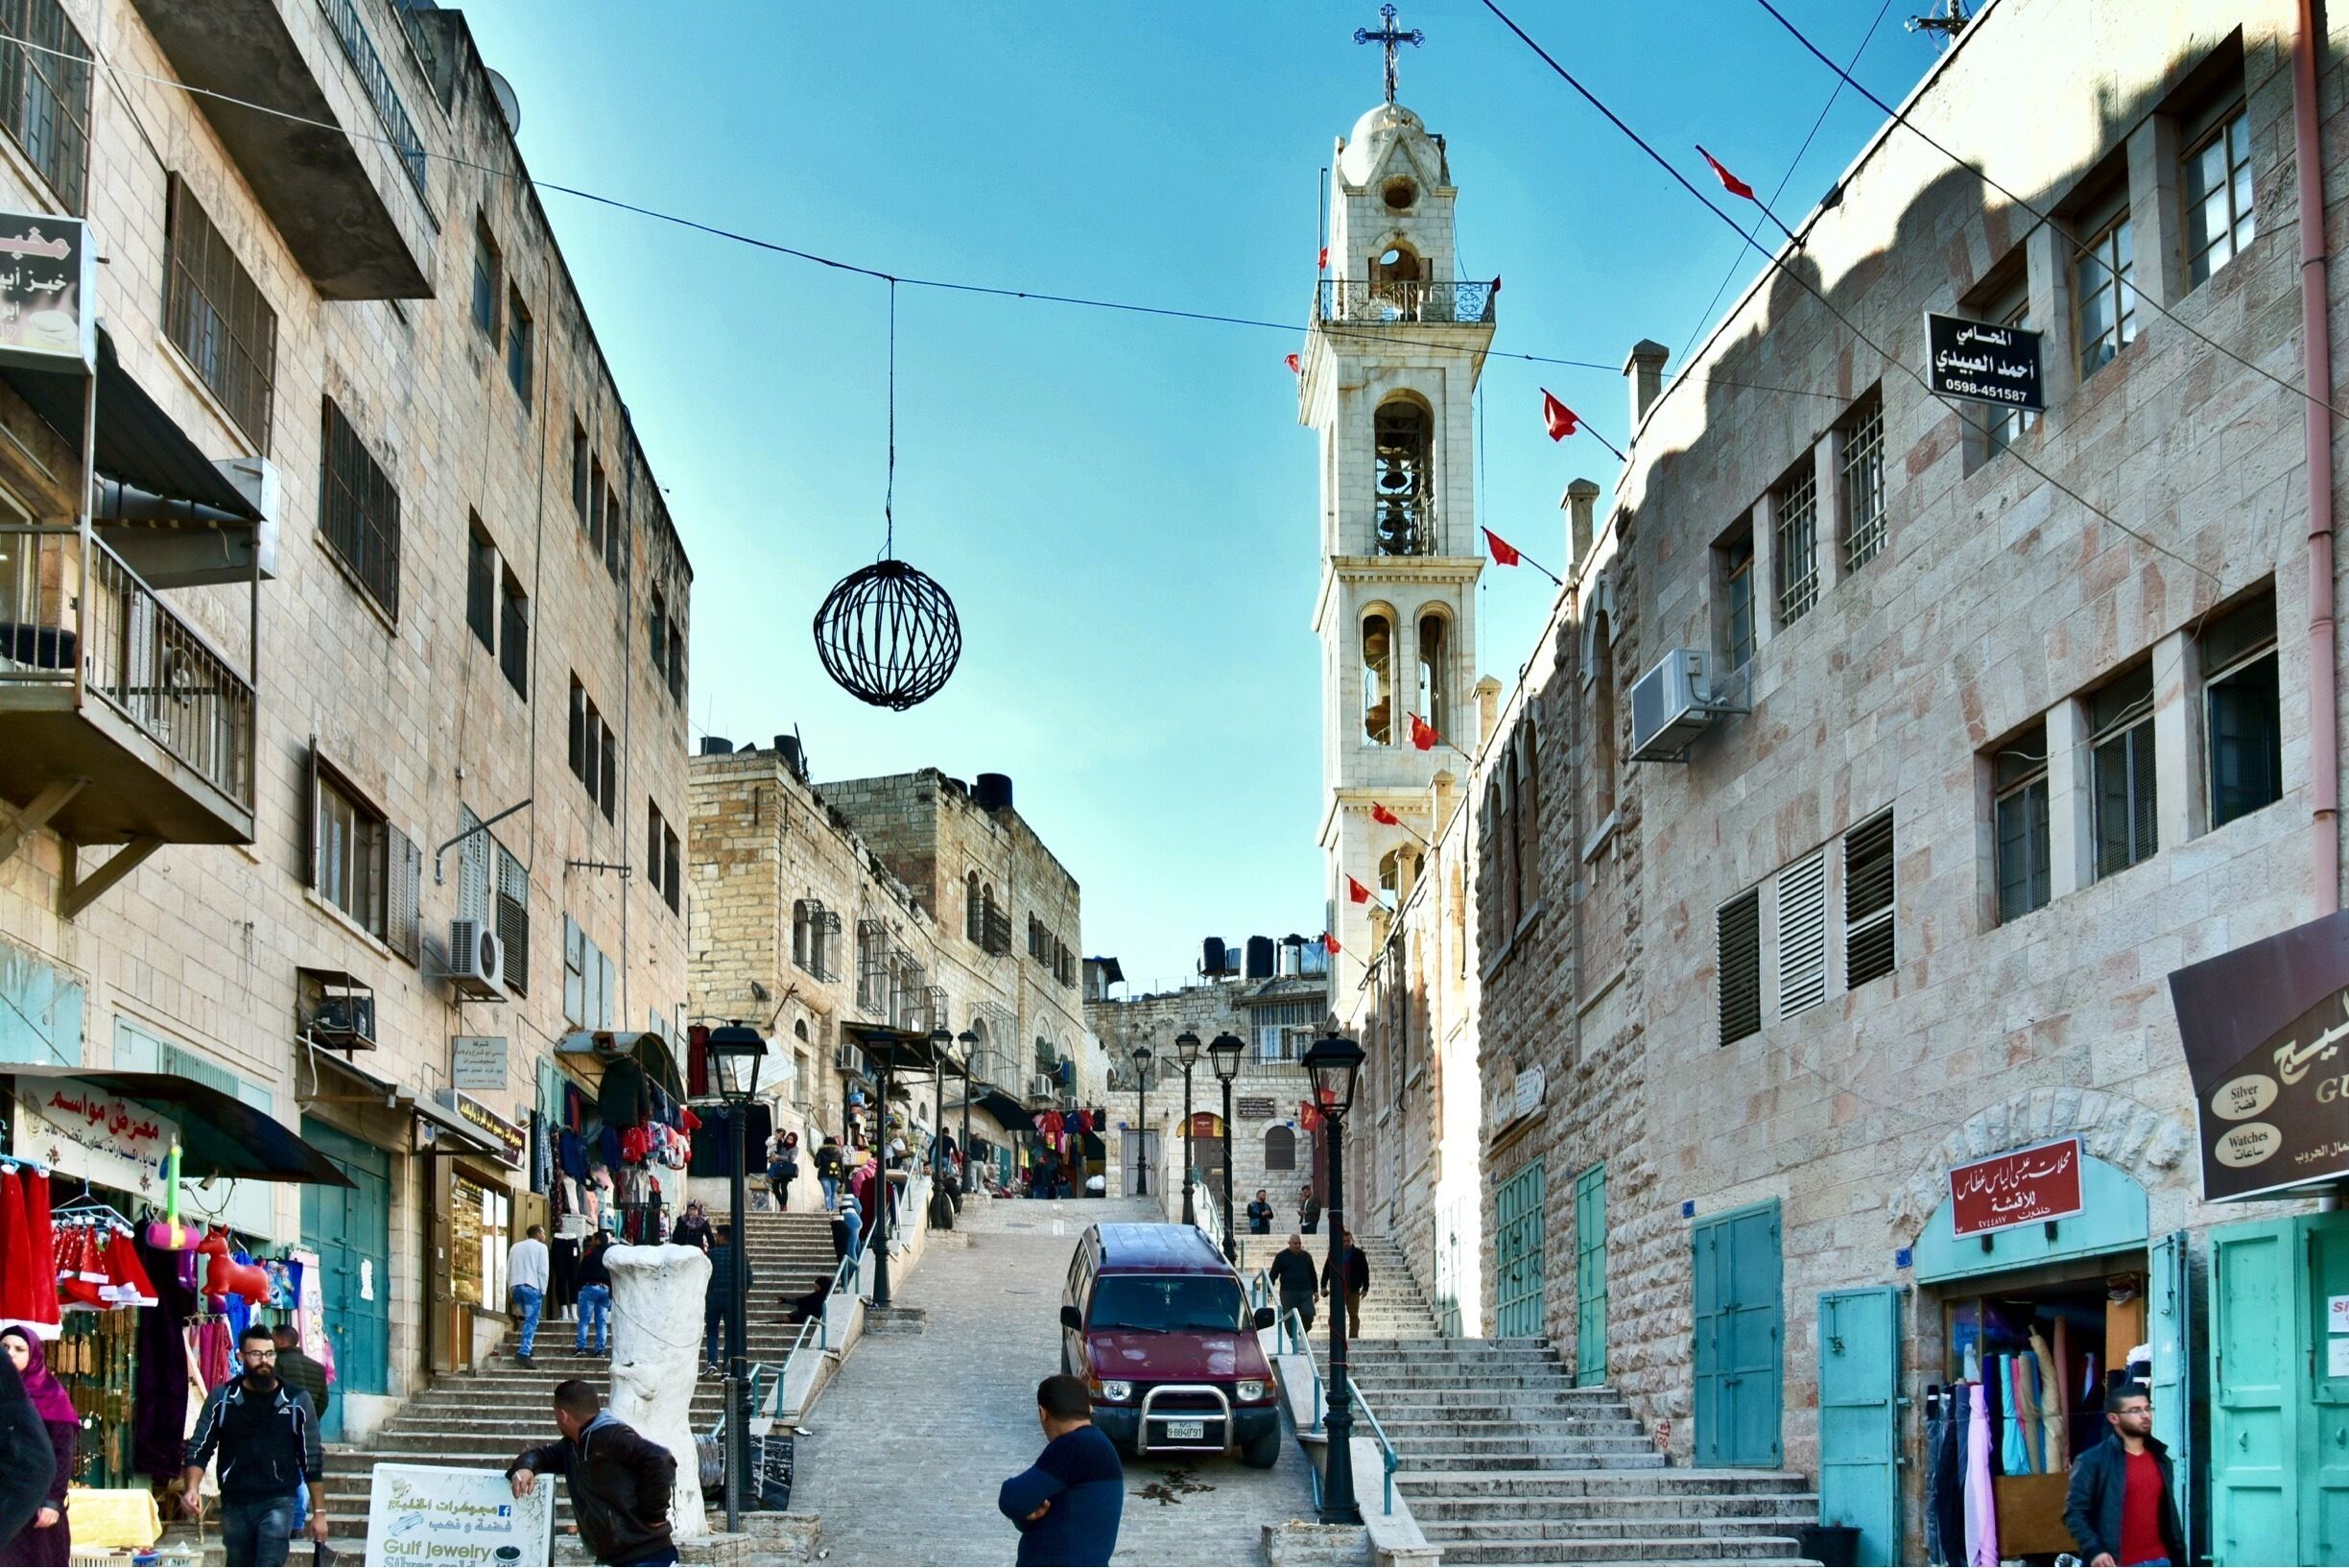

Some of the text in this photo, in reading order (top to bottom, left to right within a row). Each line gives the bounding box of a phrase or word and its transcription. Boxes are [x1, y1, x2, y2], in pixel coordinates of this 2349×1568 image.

[0, 226, 71, 260] مخب
[0, 266, 67, 295] خبز أبي
[1957, 325, 2011, 346] المحامي
[1935, 349, 2034, 381] أحمد العبيدي
[1945, 378, 2028, 402] 0598-451587
[2230, 1085, 2259, 1100] Silver
[47, 1090, 159, 1140] معرض مواسم
[2228, 1131, 2268, 1149] Watches
[2234, 1146, 2265, 1160] ساعات
[2028, 1151, 2072, 1178] محلات
[1957, 1168, 1986, 1200] غطاس
[2017, 1205, 2051, 1221] تلفون
[387, 1497, 498, 1517] مجوهرات الخليج
[384, 1538, 422, 1556] Gulf
